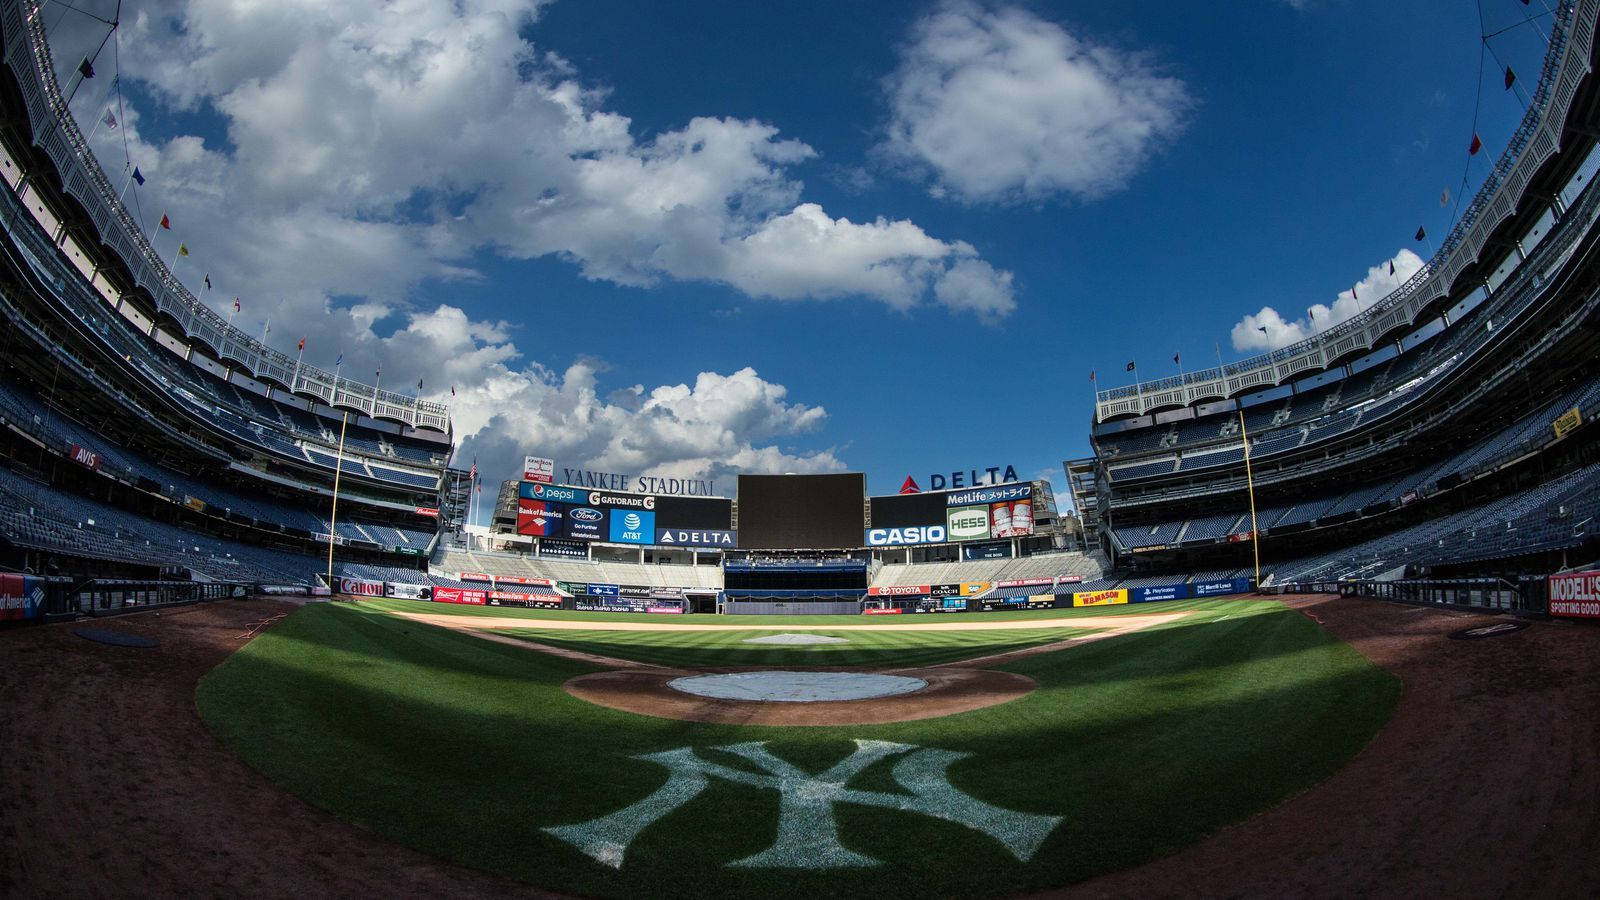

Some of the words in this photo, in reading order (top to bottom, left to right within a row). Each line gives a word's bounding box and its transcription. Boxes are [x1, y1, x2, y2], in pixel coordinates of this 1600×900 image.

[76, 448, 96, 467] AVIS
[563, 468, 629, 491] YANKEE
[638, 476, 714, 496] STADIUM
[931, 464, 1018, 490] DELTA
[546, 489, 574, 499] pepsi
[947, 493, 987, 505] MetLife
[989, 486, 1031, 500] メットライフ
[601, 496, 642, 507] GATORADE
[518, 507, 533, 515] Bank
[539, 509, 563, 519] America
[576, 509, 597, 520] Ford
[951, 516, 986, 530] HESS
[622, 532, 642, 540] AT&T
[678, 532, 732, 544] DELTA
[869, 526, 945, 545] CASIO
[341, 578, 383, 596] Canon
[891, 586, 921, 594] TOYOTA
[1219, 582, 1232, 590] Lynch
[1551, 576, 1600, 601] MODELL'S
[6, 593, 31, 609] America
[1551, 602, 1580, 613] SPORTING
